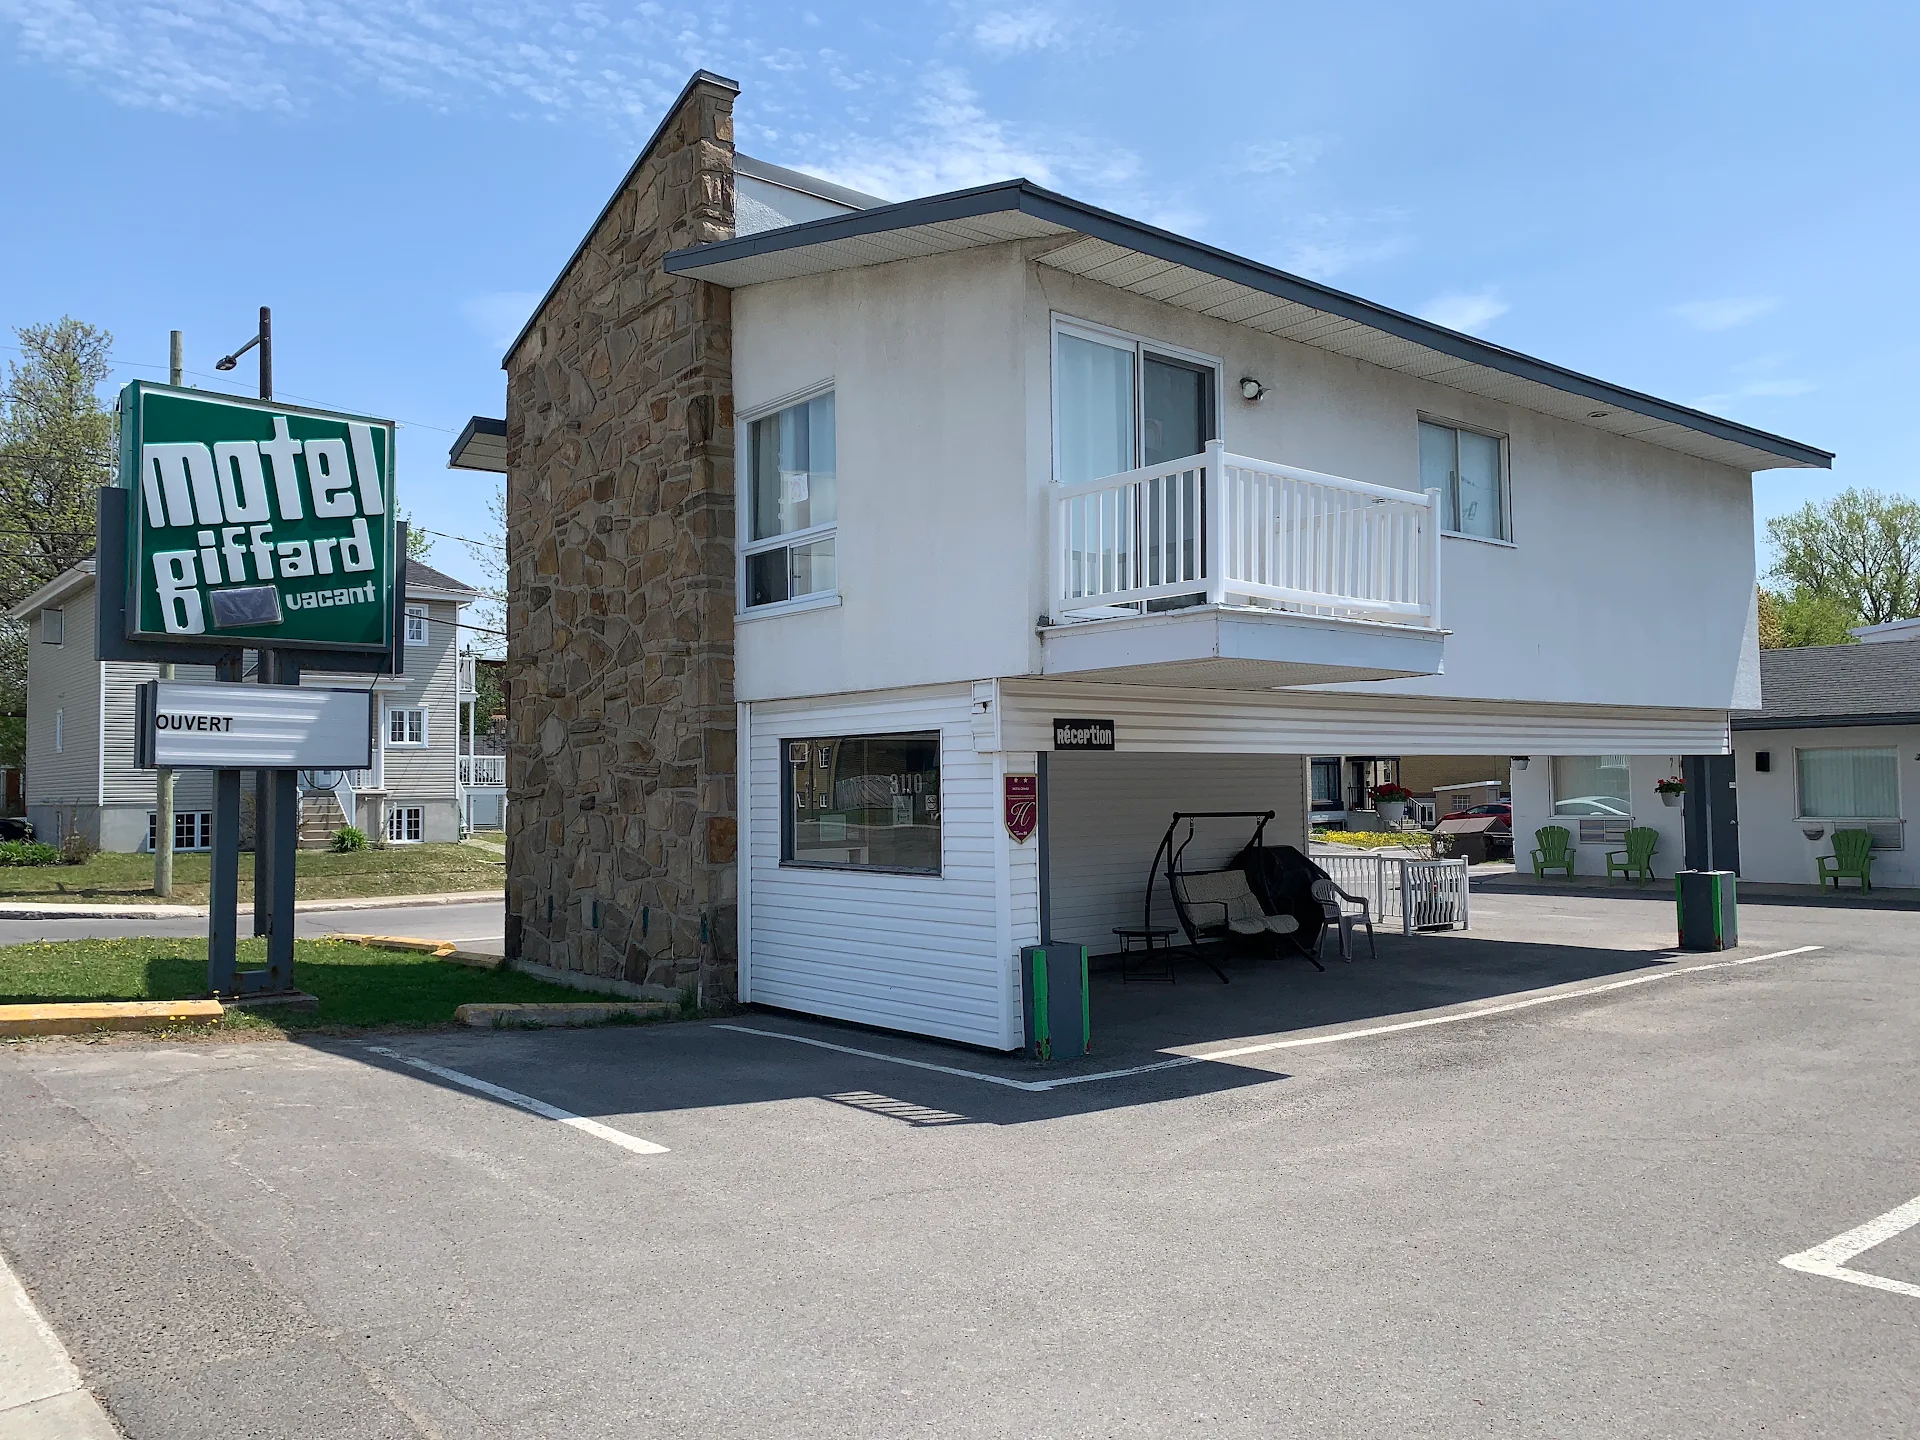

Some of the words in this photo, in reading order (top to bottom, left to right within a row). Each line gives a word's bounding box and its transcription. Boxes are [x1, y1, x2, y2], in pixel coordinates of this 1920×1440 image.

[143, 416, 384, 528] motel
[152, 518, 375, 634] giffard
[286, 580, 376, 610] vacant
[156, 714, 233, 732] OUVERT
